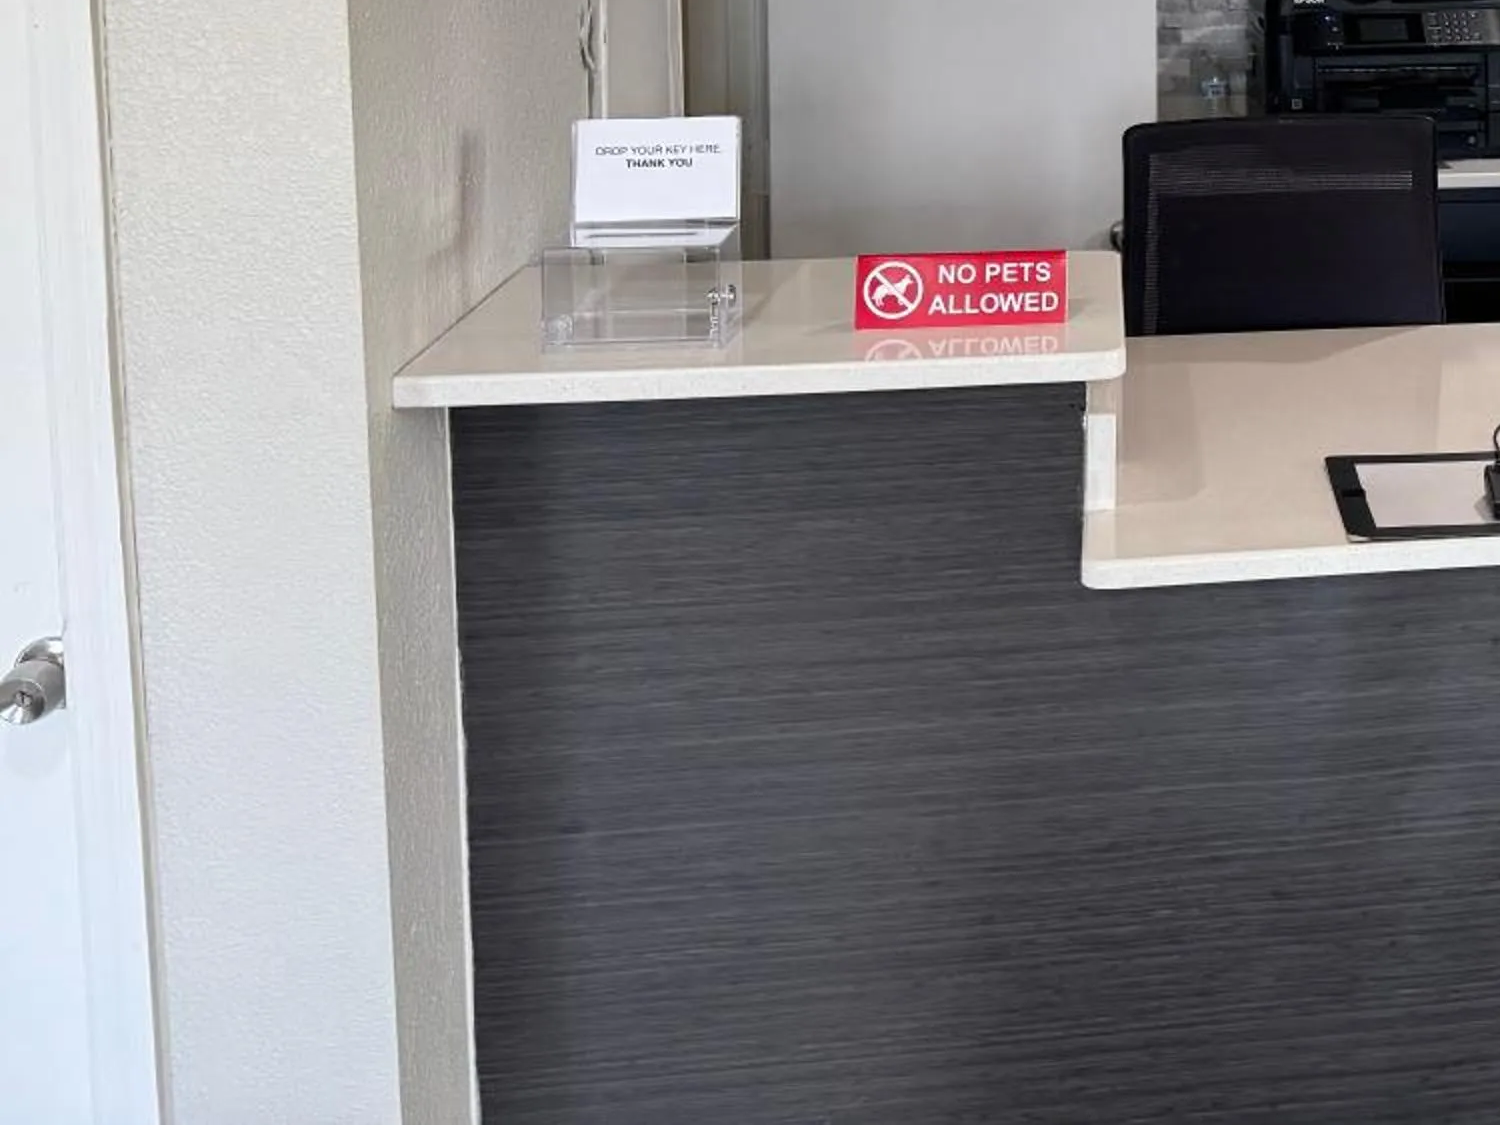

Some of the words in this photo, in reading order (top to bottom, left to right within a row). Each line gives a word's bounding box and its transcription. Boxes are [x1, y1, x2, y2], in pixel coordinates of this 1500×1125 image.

[595, 146, 628, 155] DROP
[630, 145, 663, 155] YOUR
[665, 144, 687, 154] KEY
[626, 158, 665, 168] THANK
[669, 158, 693, 167] YOU
[938, 263, 976, 284] NO
[985, 262, 1051, 283] PETS
[928, 292, 1059, 315] ALLOWED
